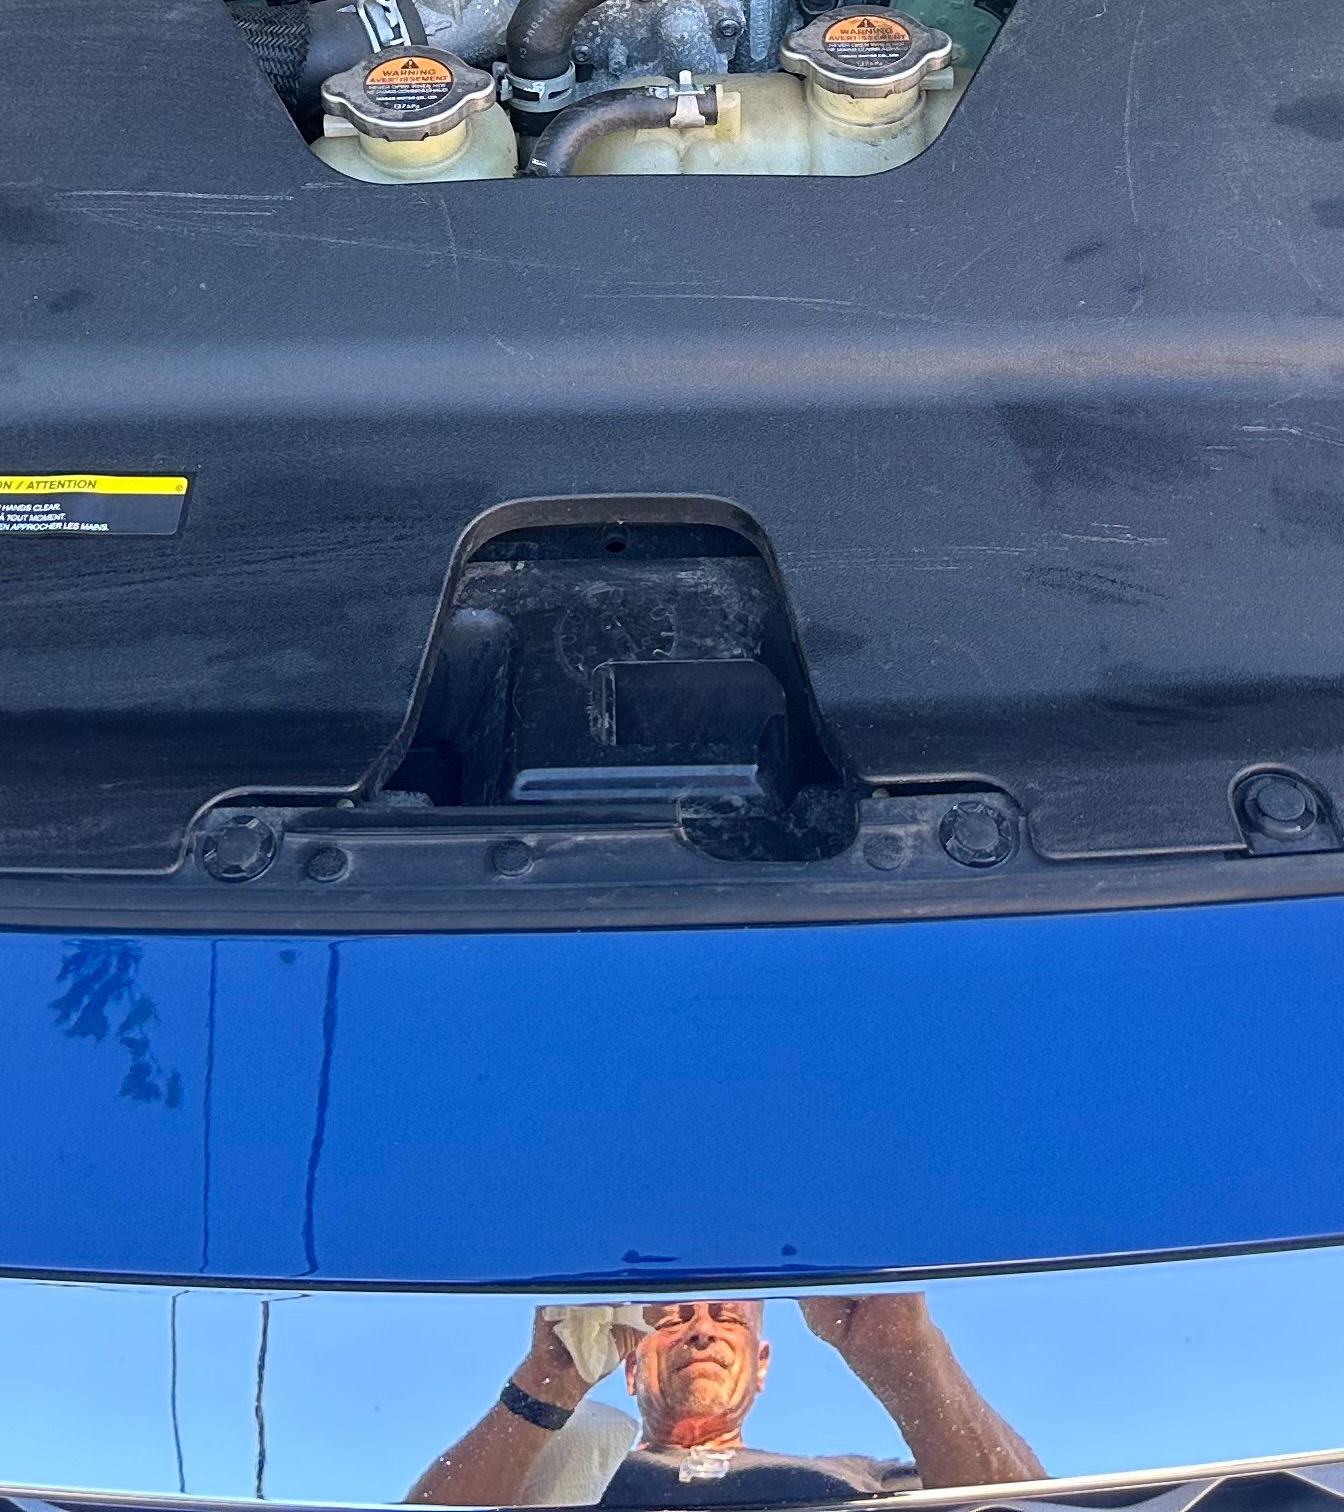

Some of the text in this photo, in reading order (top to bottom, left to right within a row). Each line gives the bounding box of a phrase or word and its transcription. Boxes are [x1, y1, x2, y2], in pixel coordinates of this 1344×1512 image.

[382, 68, 437, 76] WARNING
[15, 480, 24, 489] /
[26, 479, 98, 489] ATTENTION
[32, 503, 60, 511] CLEAR.
[10, 522, 63, 531] APPROCHER
[63, 522, 80, 530] LES
